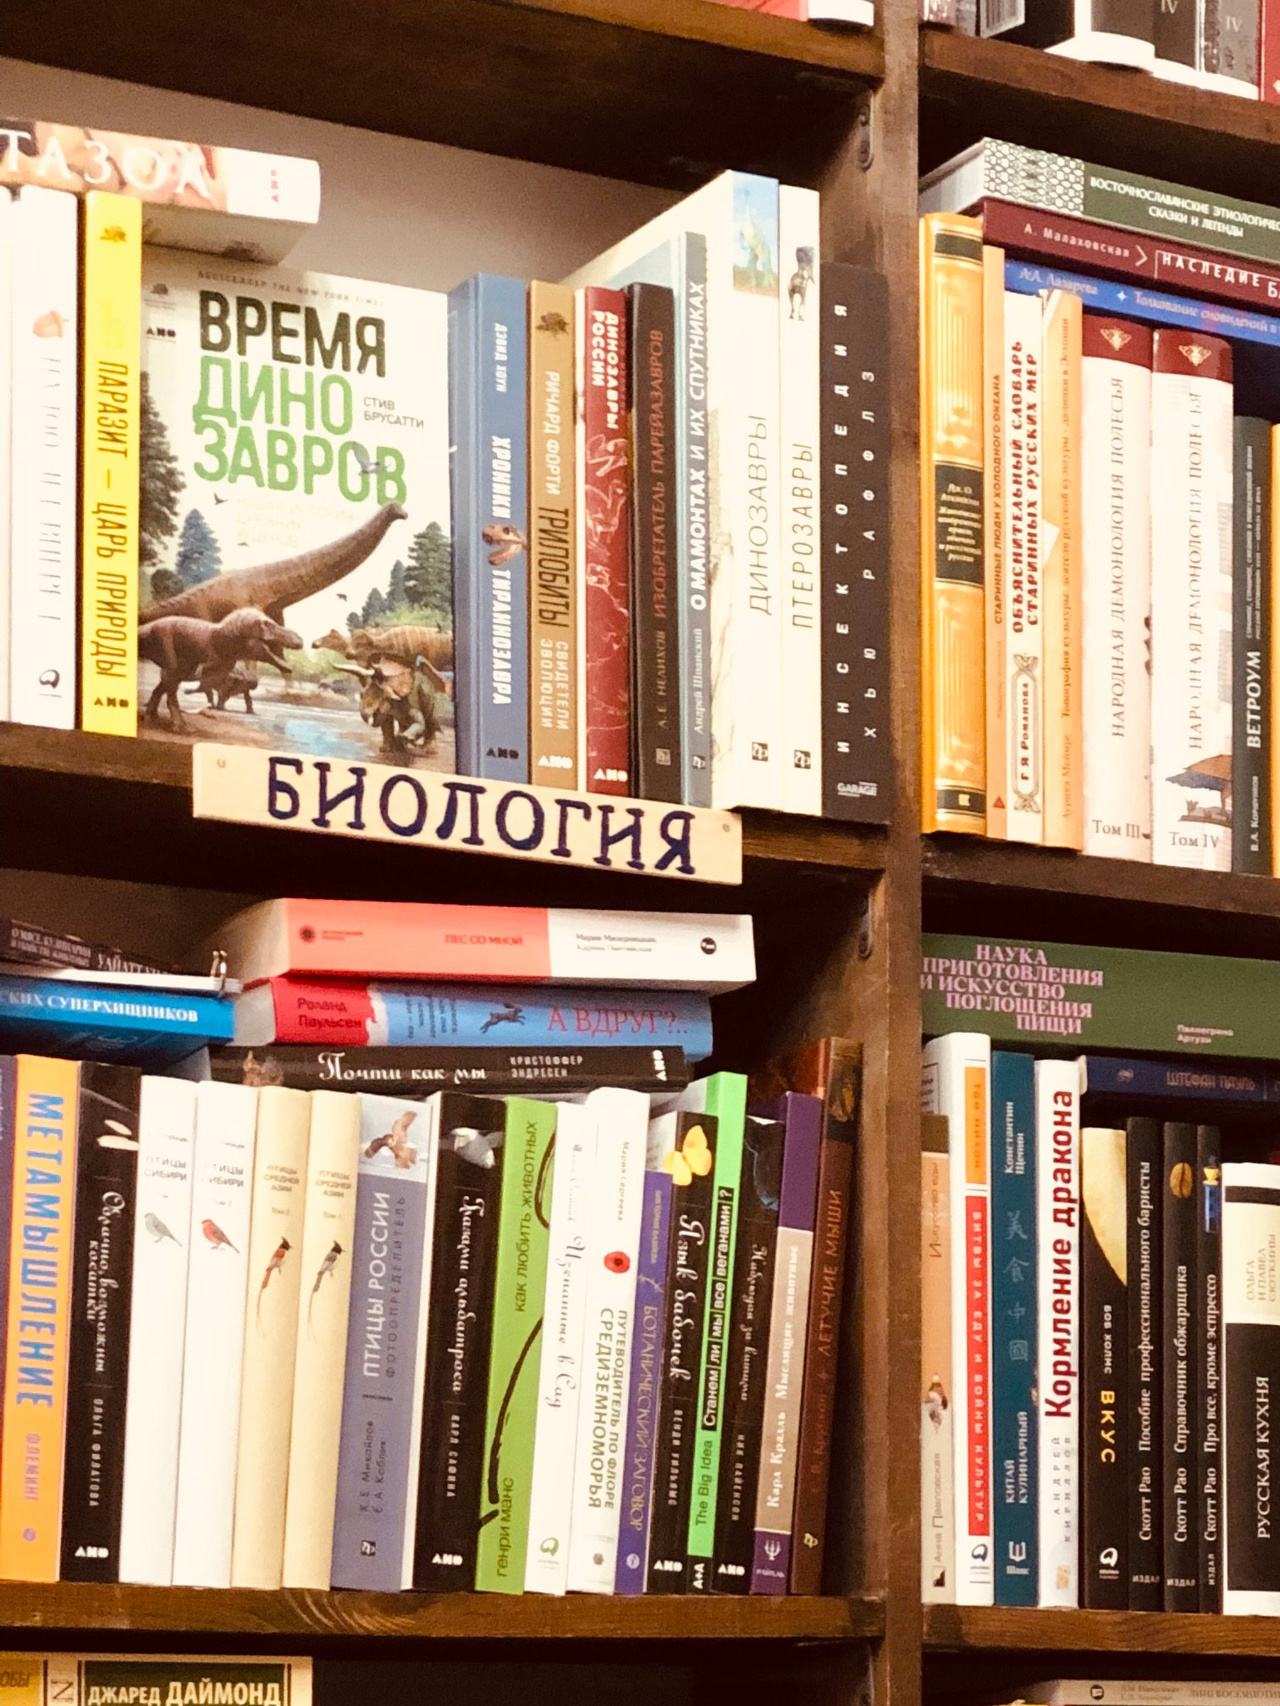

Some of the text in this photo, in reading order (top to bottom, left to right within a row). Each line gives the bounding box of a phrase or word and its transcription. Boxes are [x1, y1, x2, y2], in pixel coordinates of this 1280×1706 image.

[1162, 252, 1261, 288] НАСЛЕДИЕ
[200, 290, 386, 378] ВРЕМЯ
[590, 311, 605, 387] РОССИИ
[604, 312, 619, 430] ДИНОЗАВРЫ
[193, 356, 353, 435] ДИНО
[363, 397, 395, 410] СТИВ
[363, 411, 424, 429] БРУСАТТИ
[193, 414, 408, 507] ЗАВРОВ
[688, 281, 708, 611] О МАМОНТАХ И ИХ СПУТНИКАХ
[94, 361, 129, 679] ПАРАЗИТ ЦАРЬ ПРИРОДЫ
[748, 415, 772, 616] ДИНОЗАВРЫ
[792, 444, 814, 630] ПТЕРОЗАВРЫ
[491, 436, 512, 705] ХРОНИКИ ТИРАННОЗАВРА
[538, 506, 570, 628] ТРИЛОБИТЫ
[1246, 650, 1262, 748] ВЕТРОУМ
[266, 756, 698, 876] БИОЛОГИЯ
[923, 957, 1104, 986] ПРИГОТОВЛЕНИЯ
[938, 976, 1065, 999] ИСКУССТВО
[975, 945, 1047, 965] НАУКА
[296, 996, 348, 1014] Роланд
[296, 1014, 363, 1032] Паульсен
[945, 992, 1093, 1018] ПОГЛОЩЕНИЯ
[1016, 1014, 1082, 1035] ПИЩИ
[318, 1052, 487, 1086] Почти как мы
[15, 1093, 65, 1409] МЕТАМЫШЛЕНИЕ
[364, 1191, 391, 1378] ПТИЦЫ РОССИИ
[1044, 1090, 1073, 1419] Кормление дракона
[669, 1214, 704, 1381] Язык бабочек
[1138, 1161, 1152, 1542] Скотт Рао Пособие профессионального баристы
[1100, 1390, 1116, 1464] ВКУС
[1174, 1265, 1189, 1543] Скотт Рао Справочник обжарщика
[695, 1440, 714, 1526] The Big Idea
[1257, 1376, 1271, 1539] РУССКАЯ КУХНЯ
[88, 1685, 161, 1706] ДЖАРЕД
